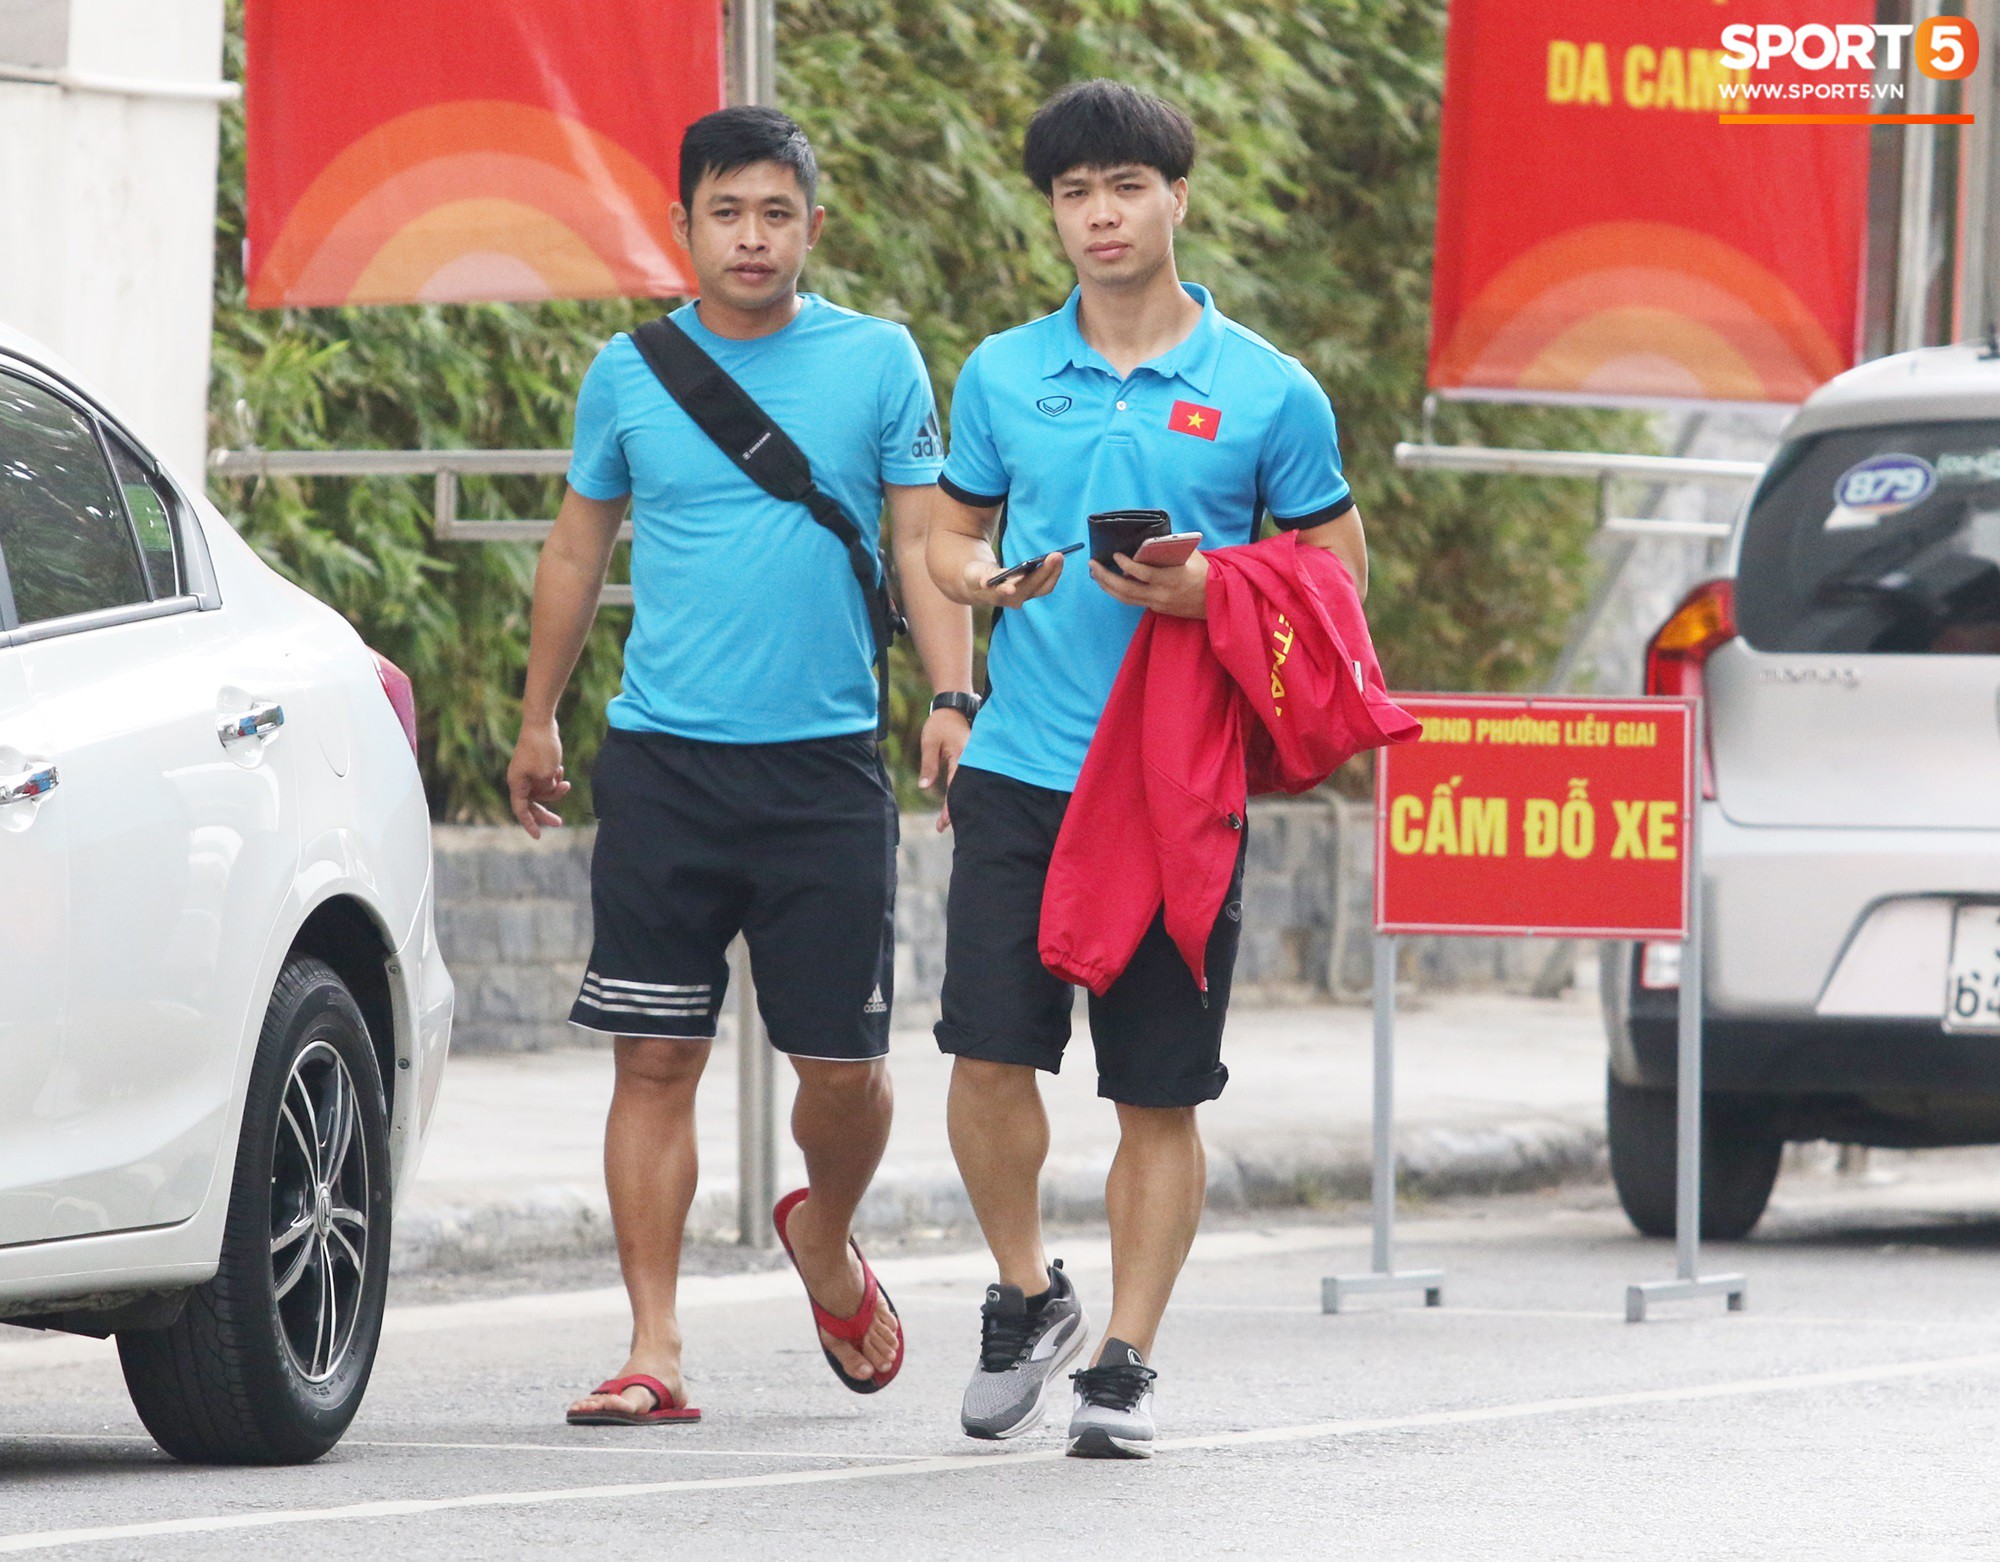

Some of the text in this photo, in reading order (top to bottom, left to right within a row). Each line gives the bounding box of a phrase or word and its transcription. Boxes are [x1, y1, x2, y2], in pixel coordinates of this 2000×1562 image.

[1547, 39, 1612, 107] DA
[1845, 467, 1924, 502] 879
[1614, 721, 1657, 747] GIAI
[1390, 775, 1678, 860] CẤM ĐỖ XE
